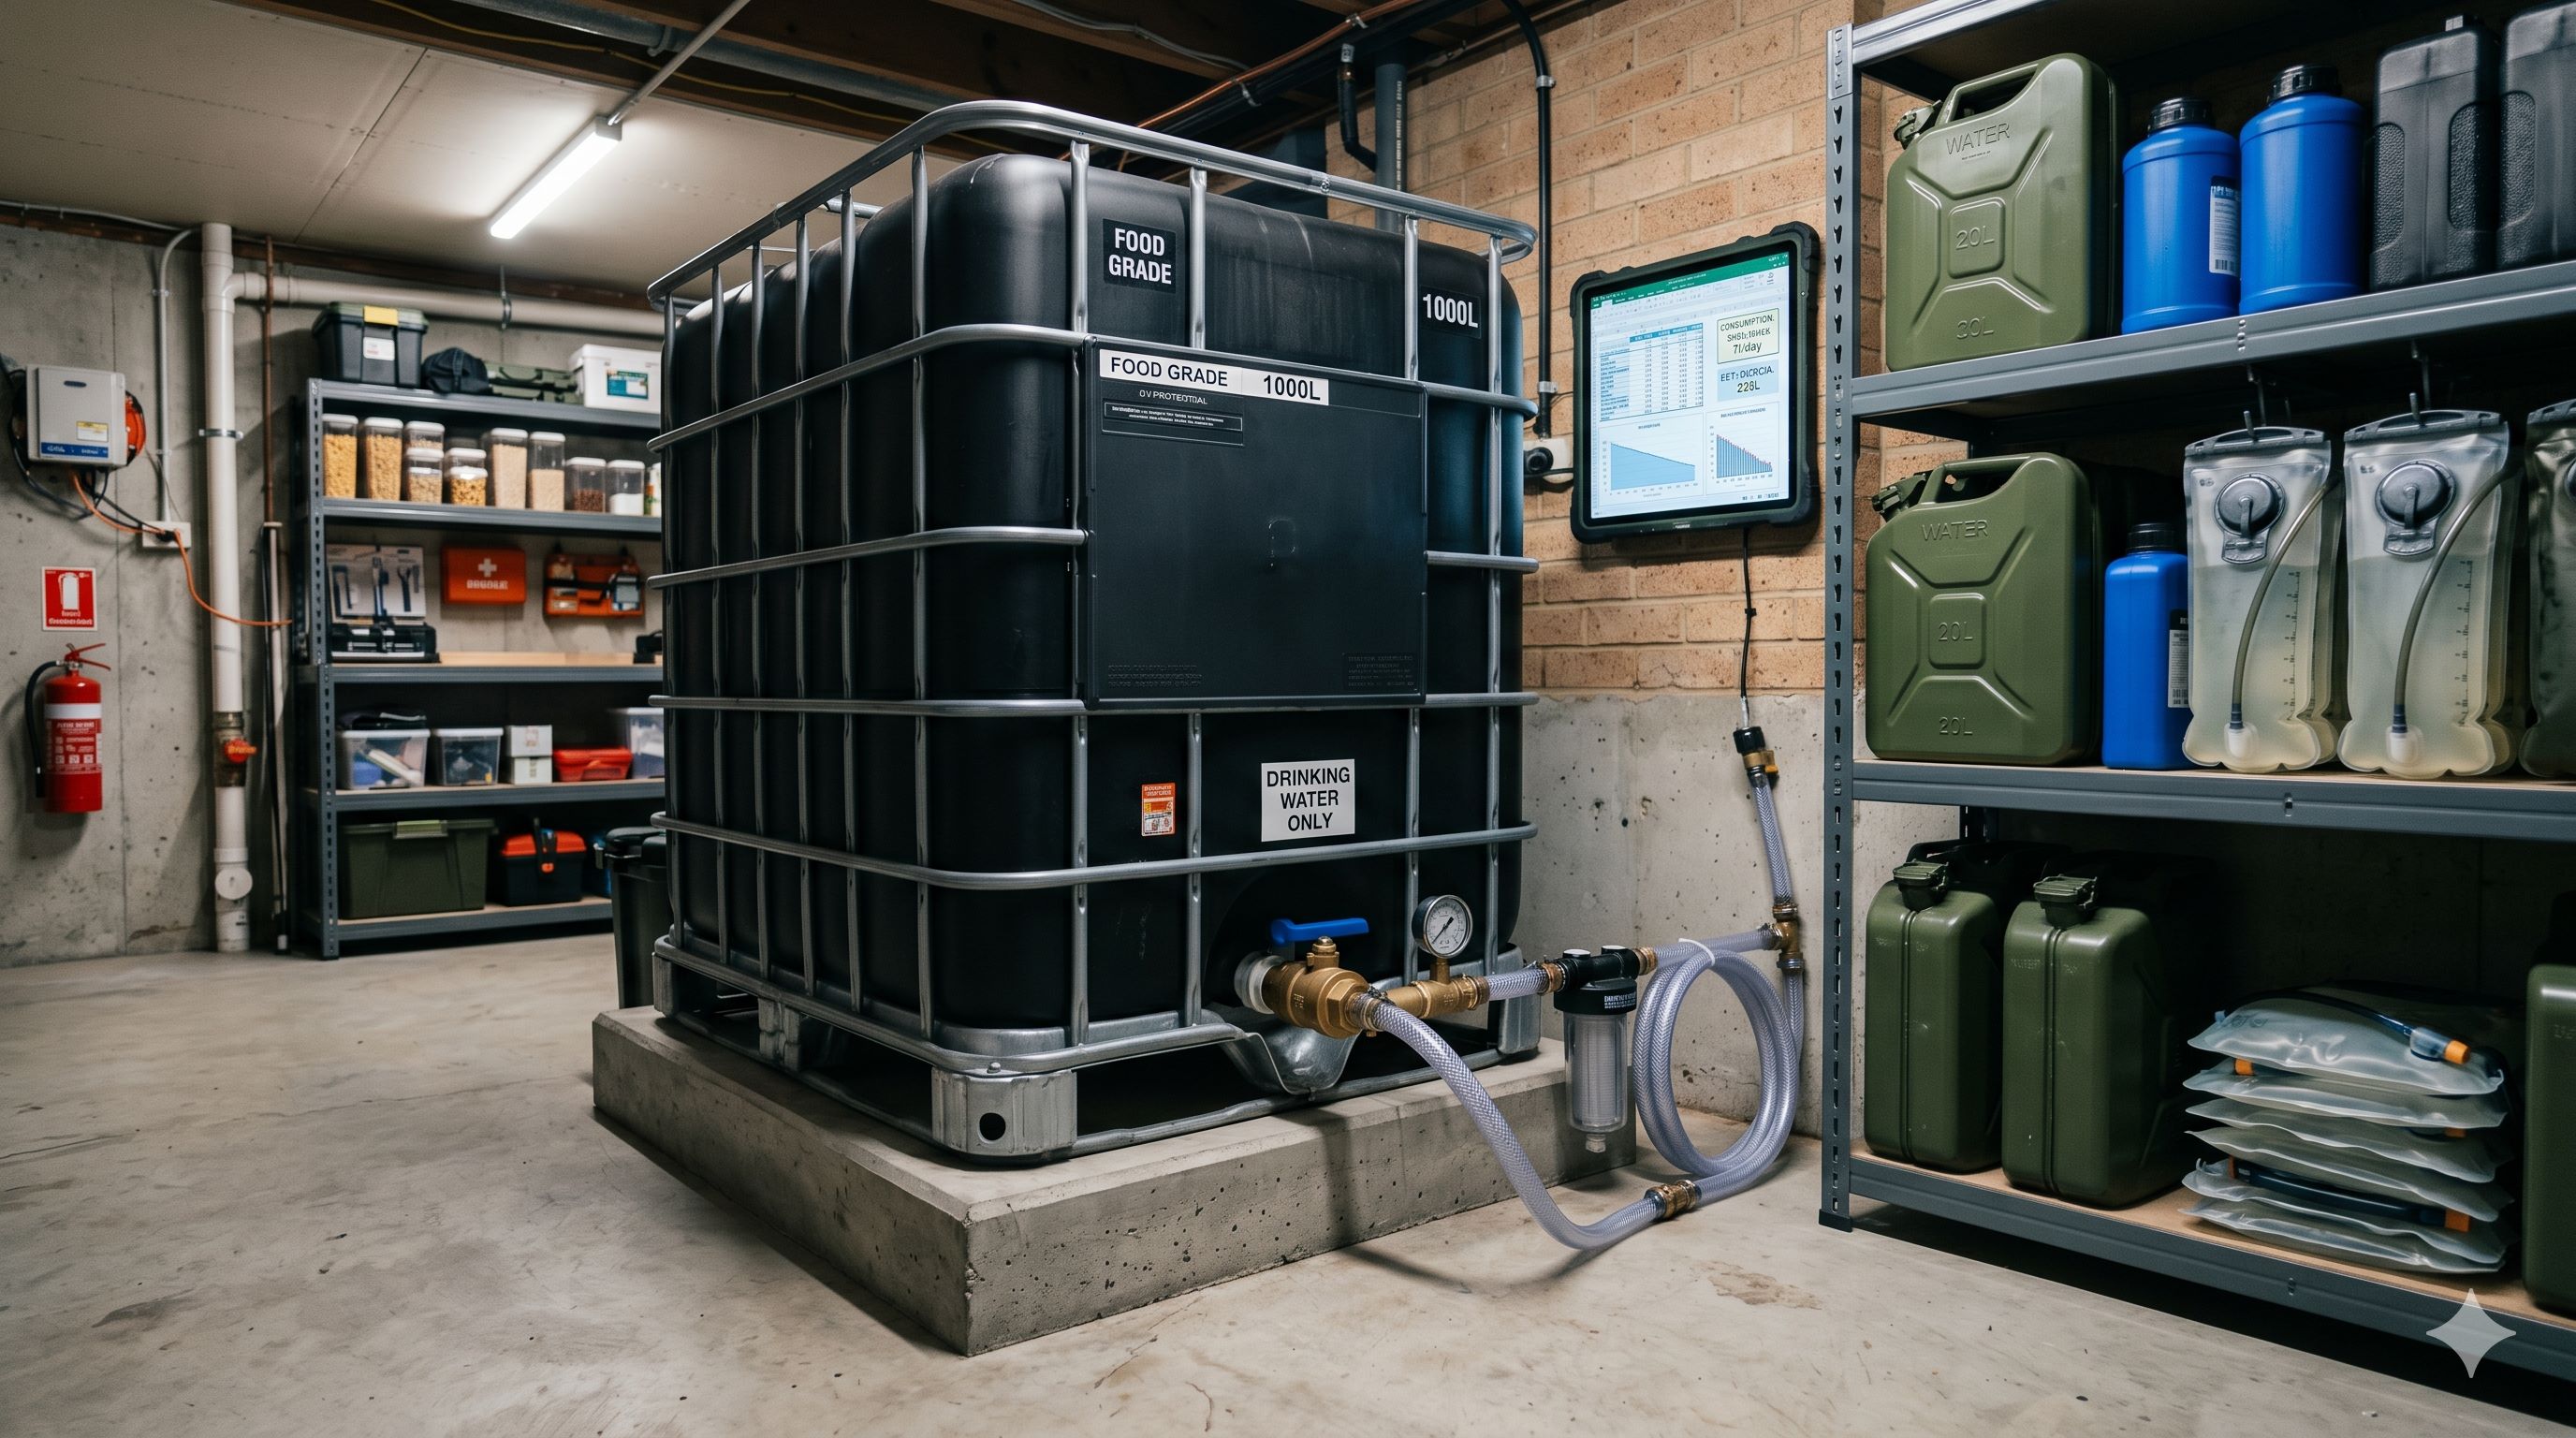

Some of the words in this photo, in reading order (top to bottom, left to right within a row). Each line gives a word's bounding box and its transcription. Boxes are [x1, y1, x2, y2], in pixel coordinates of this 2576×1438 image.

[1946, 123, 2010, 155] WATER
[1115, 227, 1164, 257] FOOD
[1955, 226, 1995, 250] 20L
[1108, 254, 1172, 285] GRADE
[1422, 293, 1479, 329] 1000L
[1111, 357, 1163, 378] FOOD
[1167, 363, 1228, 387] GRADE
[1264, 374, 1321, 402] 1000L
[1922, 520, 1988, 541] WATER
[1939, 622, 1974, 641] 20L
[1939, 716, 1973, 736] 20L
[1266, 767, 1351, 787] DRINKING
[1280, 789, 1339, 810] WATER
[1287, 812, 1334, 832] ONLY
